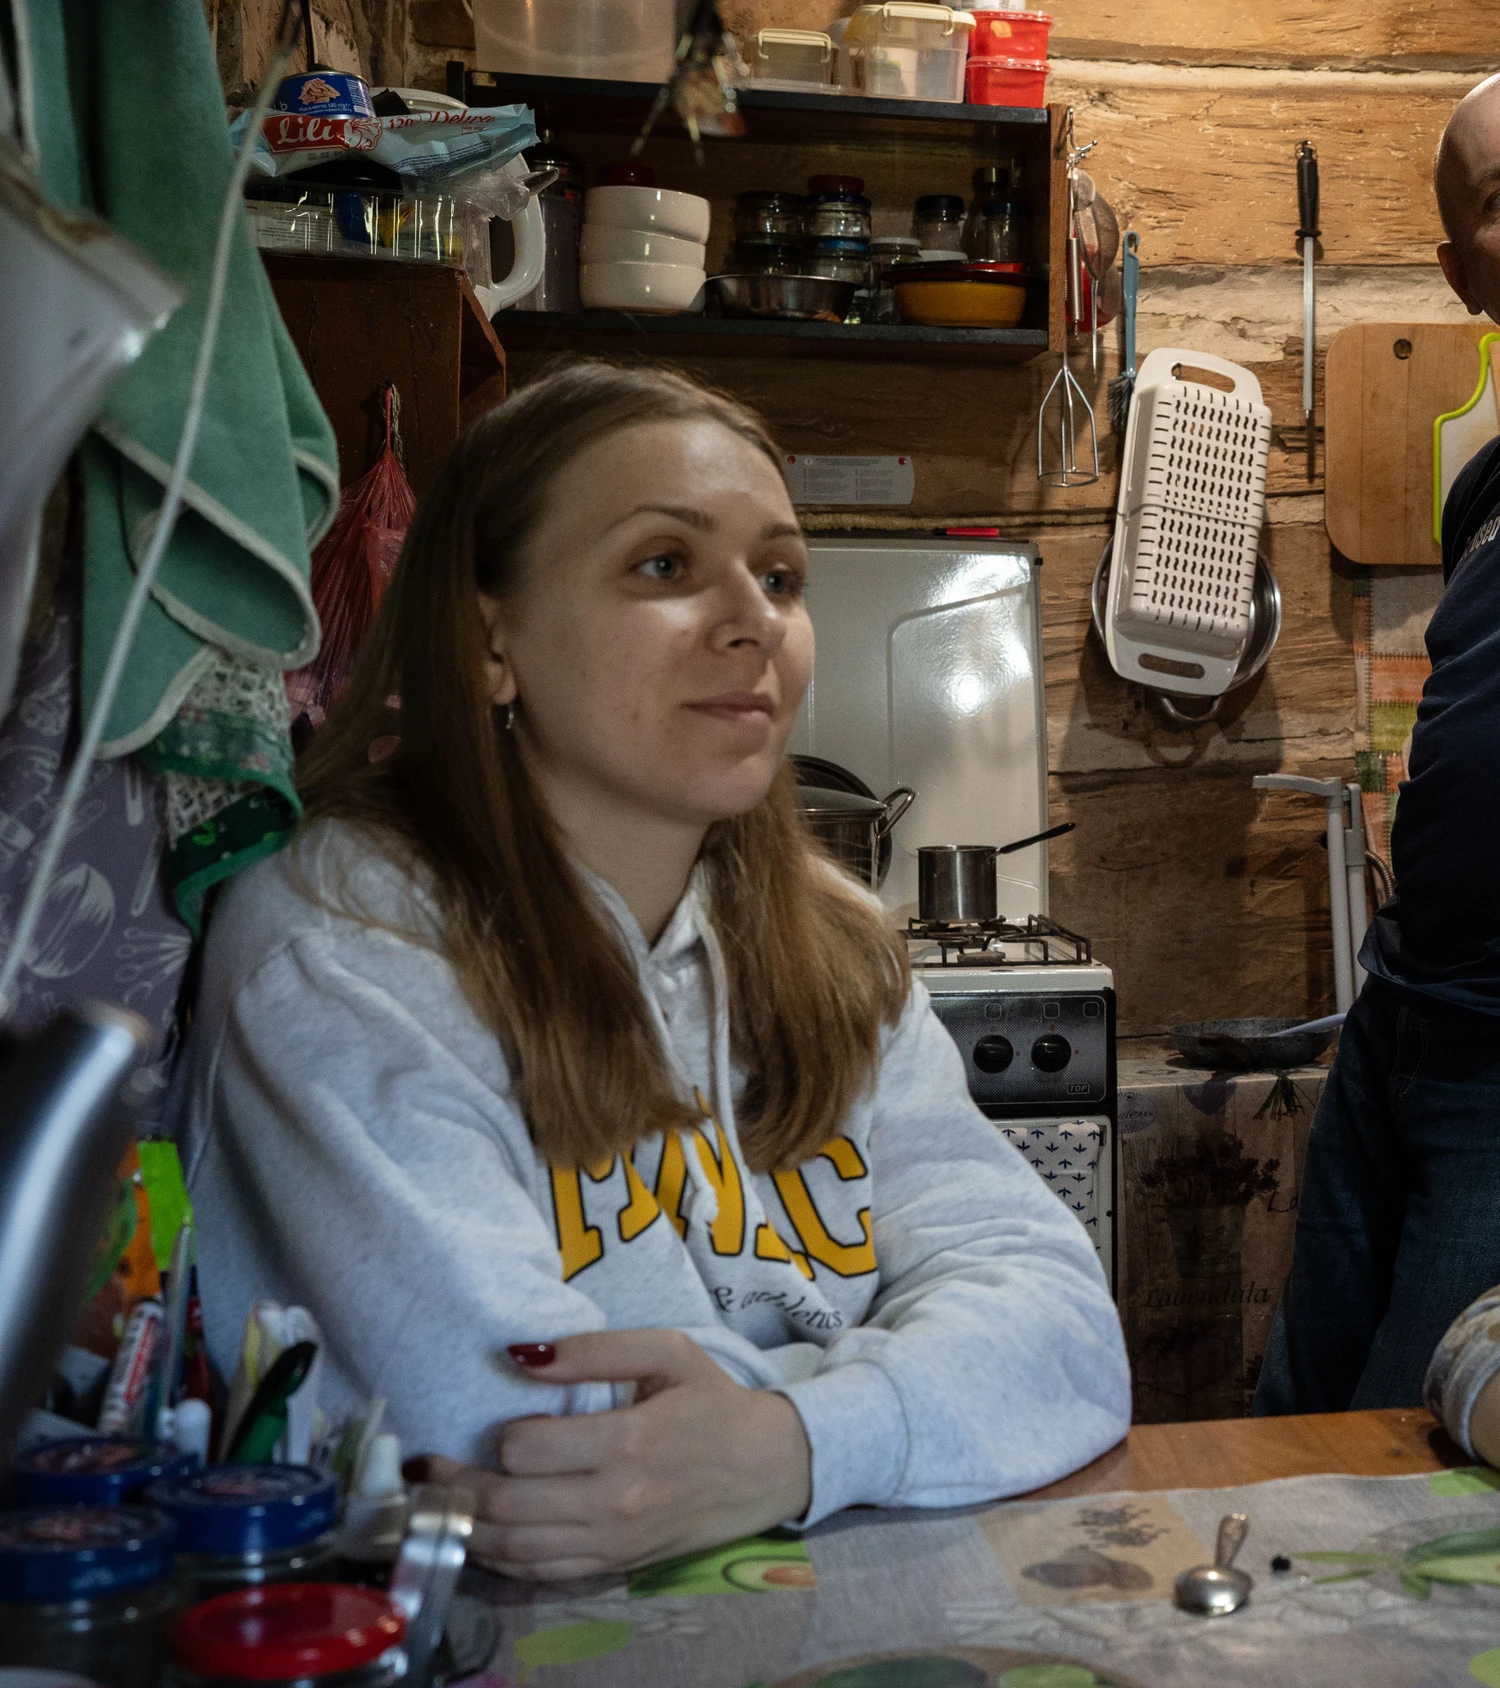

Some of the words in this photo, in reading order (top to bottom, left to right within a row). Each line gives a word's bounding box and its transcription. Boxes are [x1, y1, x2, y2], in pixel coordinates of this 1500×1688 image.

[429, 109, 496, 124] Deluxe
[277, 117, 335, 145] Lili
[1069, 1084, 1088, 1093] TOP
[1141, 1281, 1271, 1308] Lavendula
